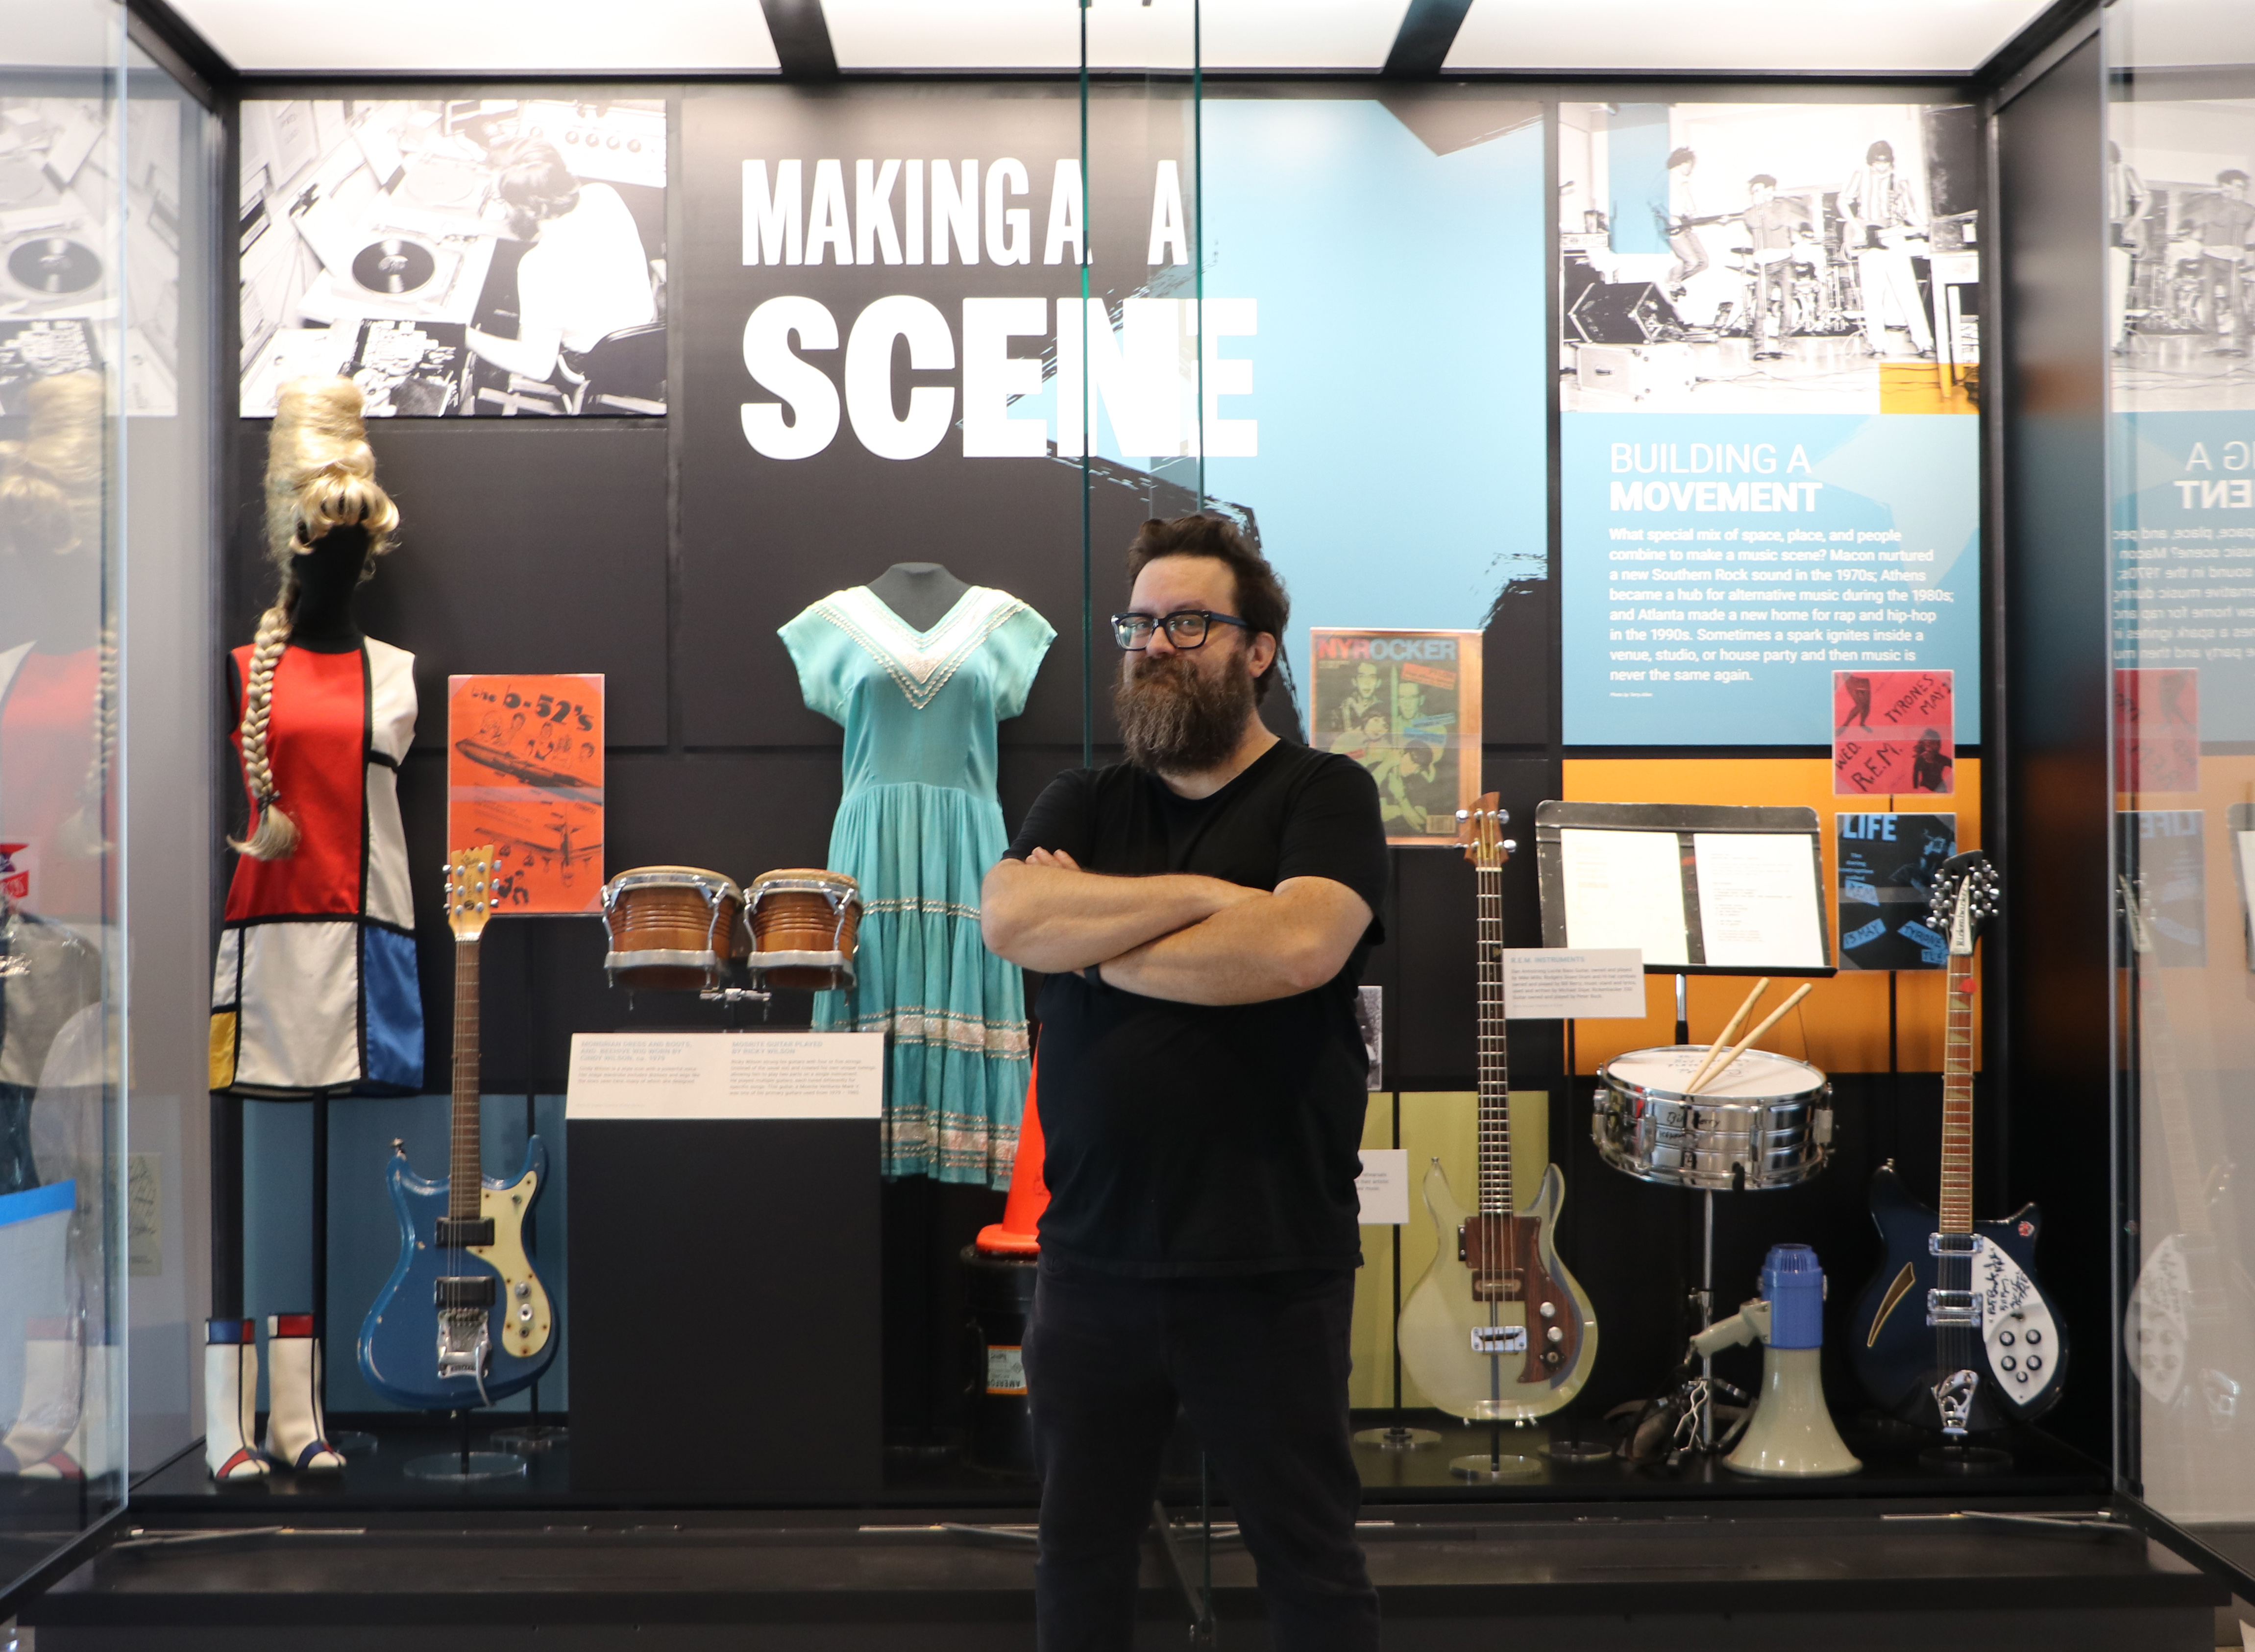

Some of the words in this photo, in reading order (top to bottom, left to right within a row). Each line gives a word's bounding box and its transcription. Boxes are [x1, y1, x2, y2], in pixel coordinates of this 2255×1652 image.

[741, 157, 1030, 267] MAKING
[1044, 159, 1093, 265] A
[740, 295, 1258, 461] SCENE
[1611, 442, 1776, 474] BUILDING
[1787, 444, 1812, 473] A
[1610, 481, 1823, 512] MOVEMENT
[1609, 528, 1643, 540] What
[1647, 529, 1693, 542] special
[1697, 529, 1721, 540] mix
[1724, 528, 1739, 540] of
[1742, 532, 1784, 543] space,
[1788, 529, 1826, 543] place,
[1829, 529, 1854, 541] and
[1857, 529, 1902, 543] people
[1609, 548, 1667, 560] combine
[1669, 550, 1683, 560] to
[1687, 549, 1723, 560] make
[1726, 551, 1735, 560] a
[1738, 549, 1778, 560] music
[1781, 549, 1827, 561] scene?
[1830, 549, 1875, 561] Macon
[1878, 549, 1933, 561] nurtured
[1610, 571, 1618, 580] a
[1621, 571, 1649, 580] new
[1652, 568, 1712, 580] Southern
[1716, 568, 1748, 580] Rock
[1752, 569, 1792, 581] sound
[1795, 569, 1808, 580] in
[1811, 569, 1832, 581] the
[1881, 569, 1926, 581] Athens
[1610, 588, 1662, 600] became
[1666, 591, 1674, 600] a
[1678, 588, 1703, 600] hub
[1706, 588, 1725, 600] for
[1728, 588, 1796, 601] alternative
[1799, 589, 1839, 601] music
[1842, 589, 1884, 604] during
[1887, 589, 1908, 601] the
[1610, 608, 1634, 620] and
[1638, 608, 1684, 620] Atlanta
[1688, 608, 1725, 620] made
[1729, 611, 1737, 620] a
[1740, 611, 1767, 620] new
[1771, 608, 1809, 620] home
[1812, 608, 1831, 620] for
[1834, 611, 1856, 623] rap
[1859, 609, 1884, 621] and
[1887, 609, 1936, 623] hip-hop
[1610, 629, 1622, 640] in
[1625, 629, 1646, 640] the
[1651, 629, 1692, 640] 1990s.
[1697, 629, 1771, 640] Sometimes
[1775, 632, 1783, 640] a
[1787, 629, 1823, 643] spark
[1827, 629, 1870, 643] ignites
[1873, 629, 1912, 641] inside
[1915, 632, 1924, 641] a
[1610, 651, 1652, 661] venue,
[1656, 649, 1699, 661] studio,
[1702, 652, 1716, 660] or
[1720, 648, 1760, 660] house
[1764, 650, 1797, 663] party
[1801, 649, 1825, 660] and
[1829, 649, 1858, 660] then
[1862, 649, 1901, 661] music
[1905, 650, 1916, 661] is
[1610, 671, 1646, 680] never
[1649, 668, 1670, 680] the
[1674, 671, 1711, 680] same
[1714, 669, 1753, 683] again.
[1843, 814, 1898, 842] LIFE
